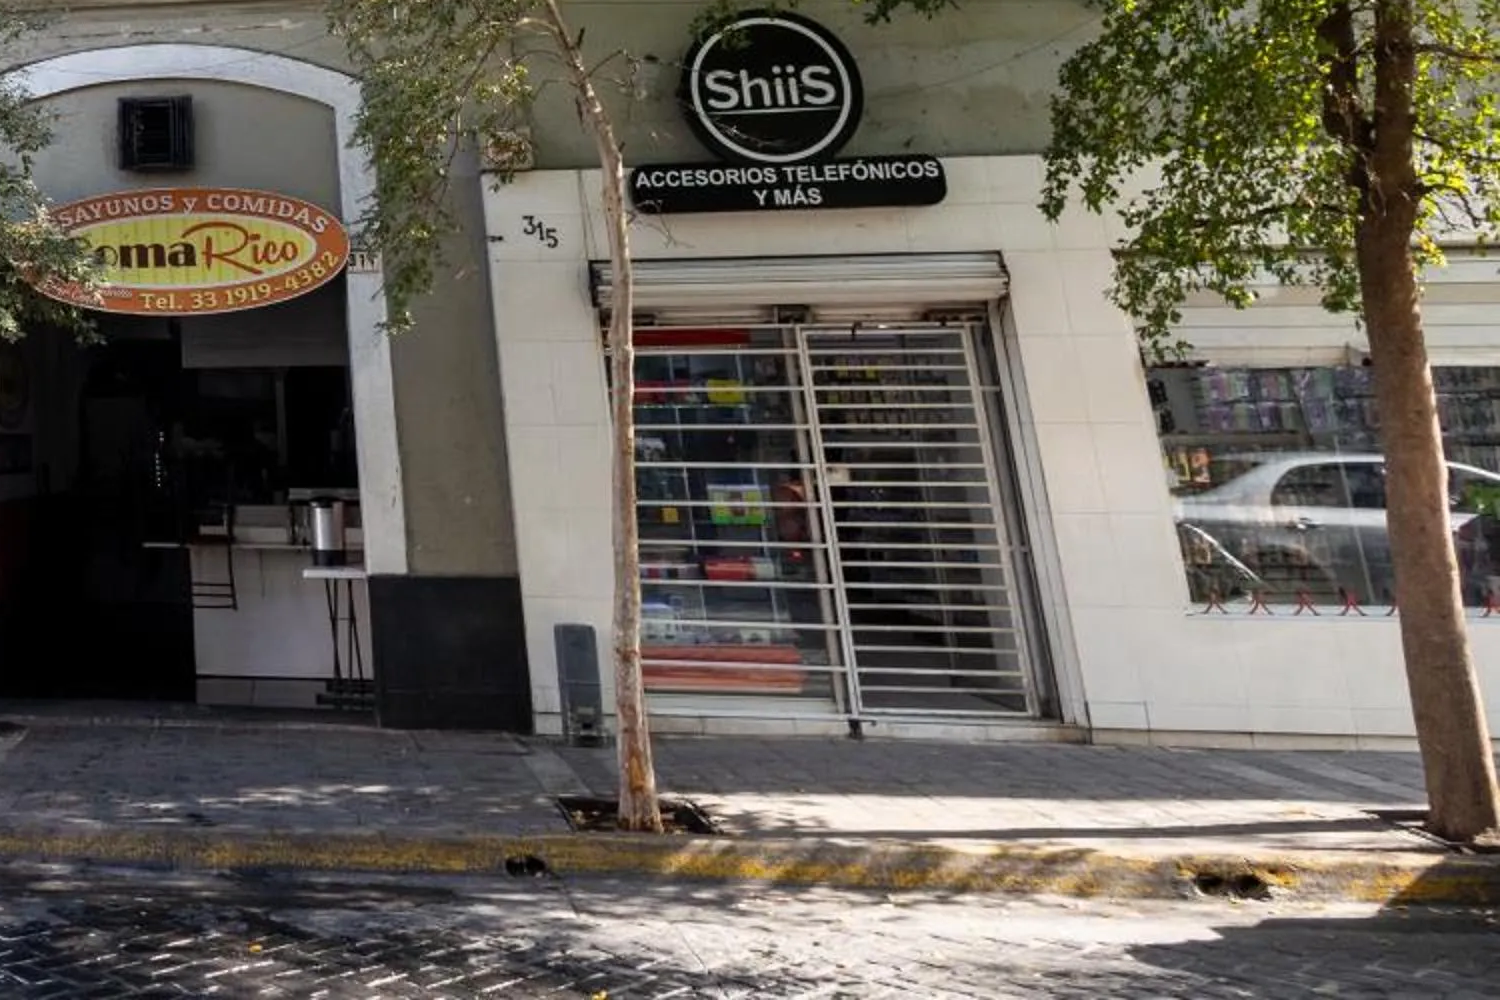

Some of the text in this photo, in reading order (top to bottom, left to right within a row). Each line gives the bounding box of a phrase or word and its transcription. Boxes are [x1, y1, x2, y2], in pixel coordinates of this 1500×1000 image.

[704, 64, 837, 110] ShiiS
[635, 159, 940, 189] ACCESORIOS TELEFÓNICOS
[753, 184, 823, 207] Y MÁS
[54, 193, 174, 229] SAYUNOS
[206, 193, 329, 234] COMIDAS
[181, 221, 299, 276] Rico
[521, 214, 559, 249] 315
[139, 292, 184, 310] Tel.
[192, 291, 218, 310] 33
